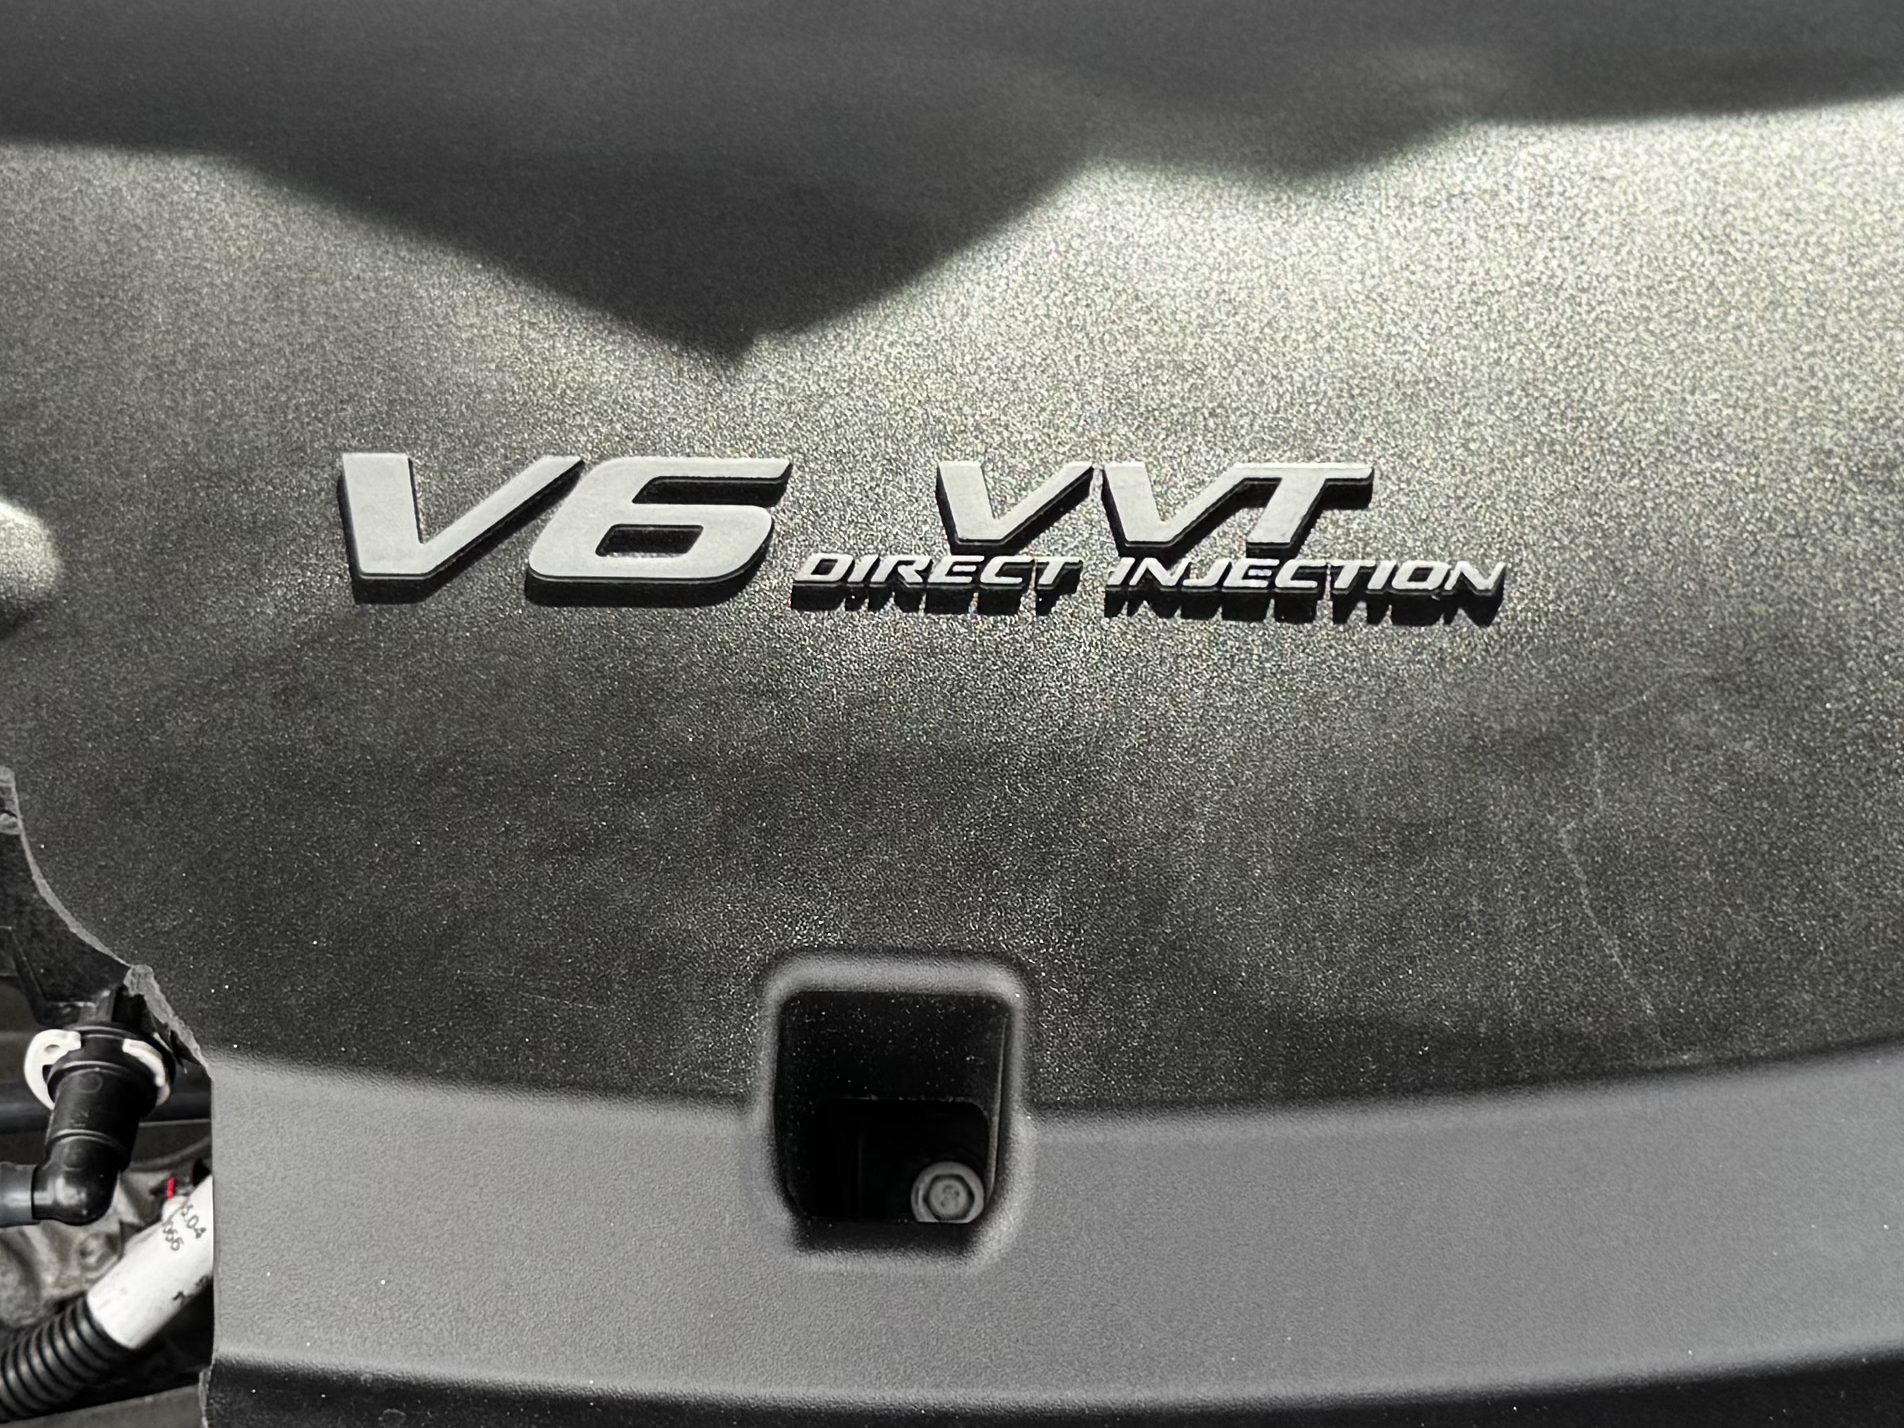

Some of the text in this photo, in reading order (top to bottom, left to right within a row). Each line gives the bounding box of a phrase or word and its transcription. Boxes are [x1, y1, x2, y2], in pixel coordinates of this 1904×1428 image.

[338, 451, 1375, 592] V6 VVT
[791, 552, 1504, 596] DIRECT INJECTION
